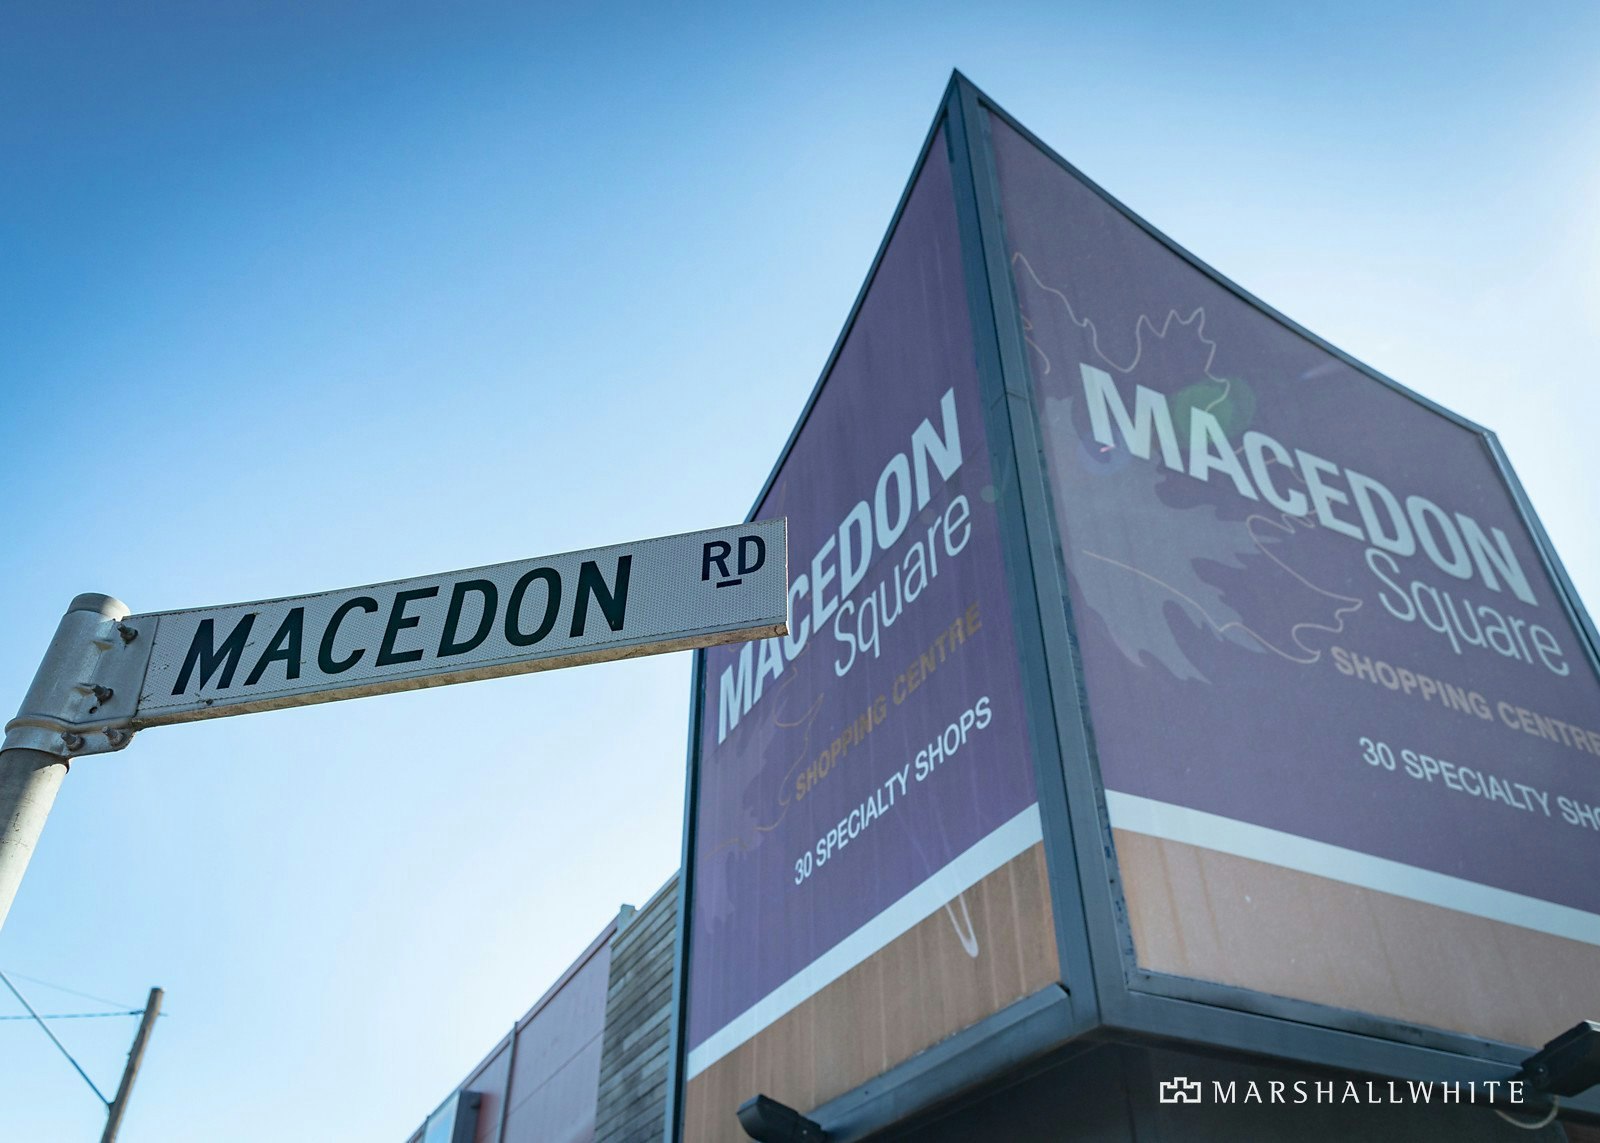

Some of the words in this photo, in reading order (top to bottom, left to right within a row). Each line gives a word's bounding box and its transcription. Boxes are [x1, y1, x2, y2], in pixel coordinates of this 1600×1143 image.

[717, 387, 963, 745] MACEDON
[1079, 362, 1539, 606] MACEDON
[171, 555, 632, 695] MACEDON
[701, 535, 766, 582] RD
[834, 493, 972, 676] Square
[1364, 548, 1569, 676] Square
[795, 694, 887, 801] SHOPPING
[892, 602, 983, 705] CENTRE
[1331, 646, 1494, 721] SHOPPING
[794, 851, 813, 885] 30
[816, 763, 910, 867] SPECIALTY
[915, 696, 992, 782] SHOPS
[1359, 737, 1396, 771] 30
[1401, 750, 1551, 817] SPECIALTY
[1557, 796, 1600, 831] SH
